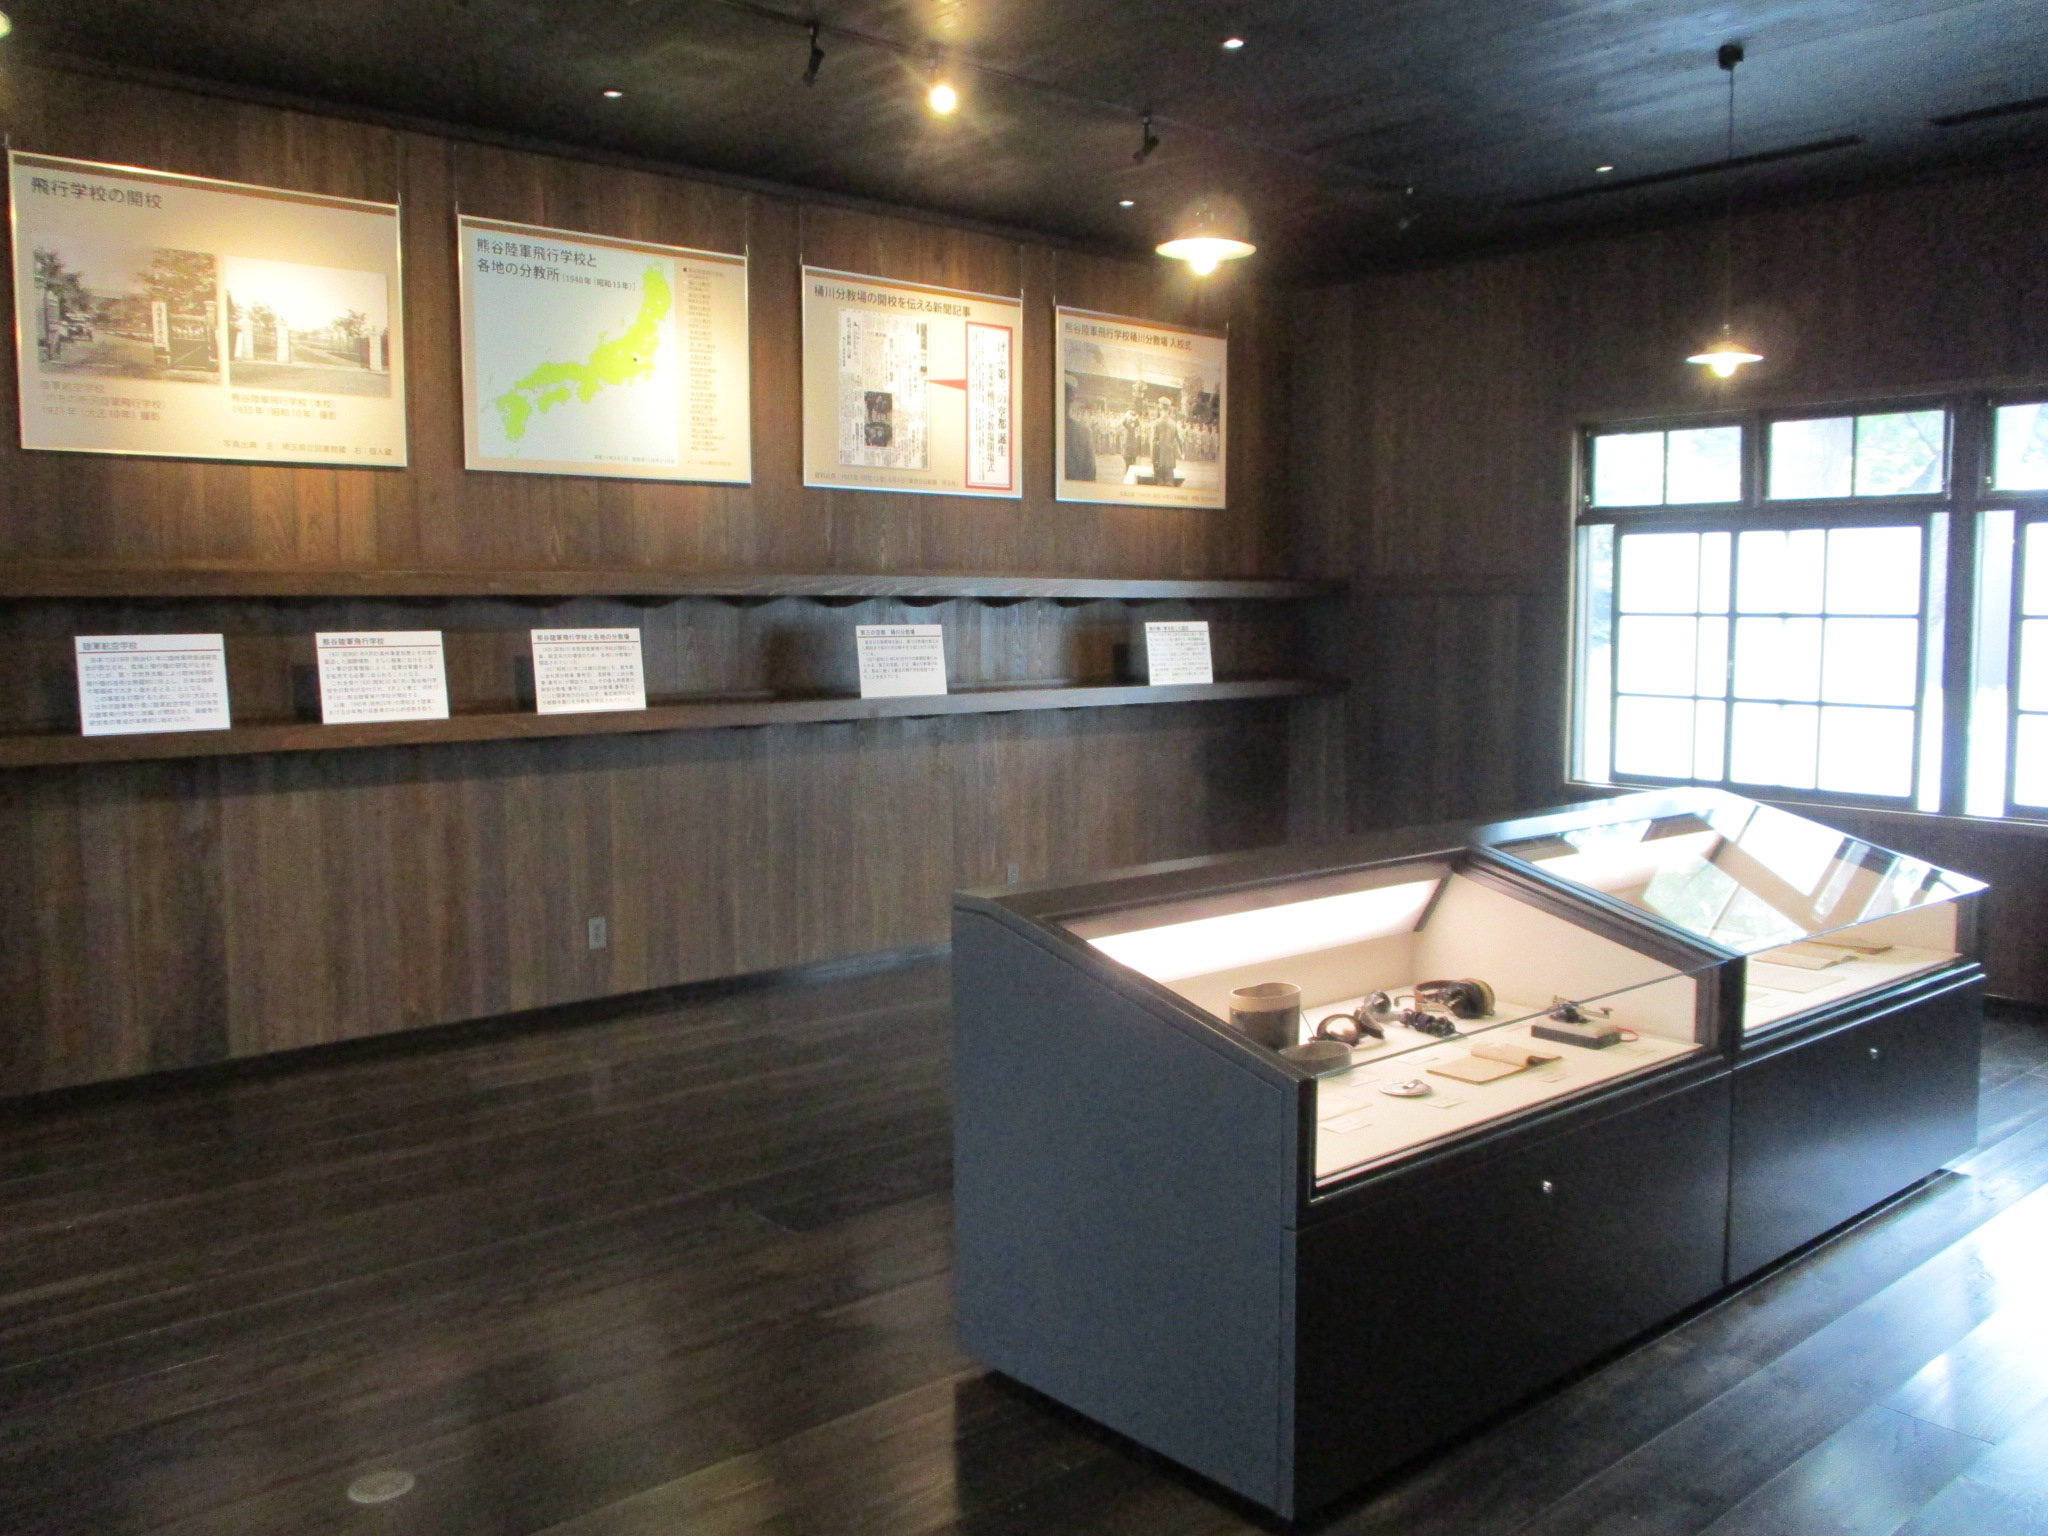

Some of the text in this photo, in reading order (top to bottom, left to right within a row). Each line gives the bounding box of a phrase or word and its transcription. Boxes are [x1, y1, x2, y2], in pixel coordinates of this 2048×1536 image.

[31, 176, 162, 209] 飛行学校の開校
[476, 237, 598, 268] 熊谷陸軍飛行学校と
[477, 258, 560, 282] 各地の分教所
[814, 283, 971, 318] 桶川分教場の開校を伝える新聞記事
[322, 636, 385, 646] 熊谷陸軍飛行学校
